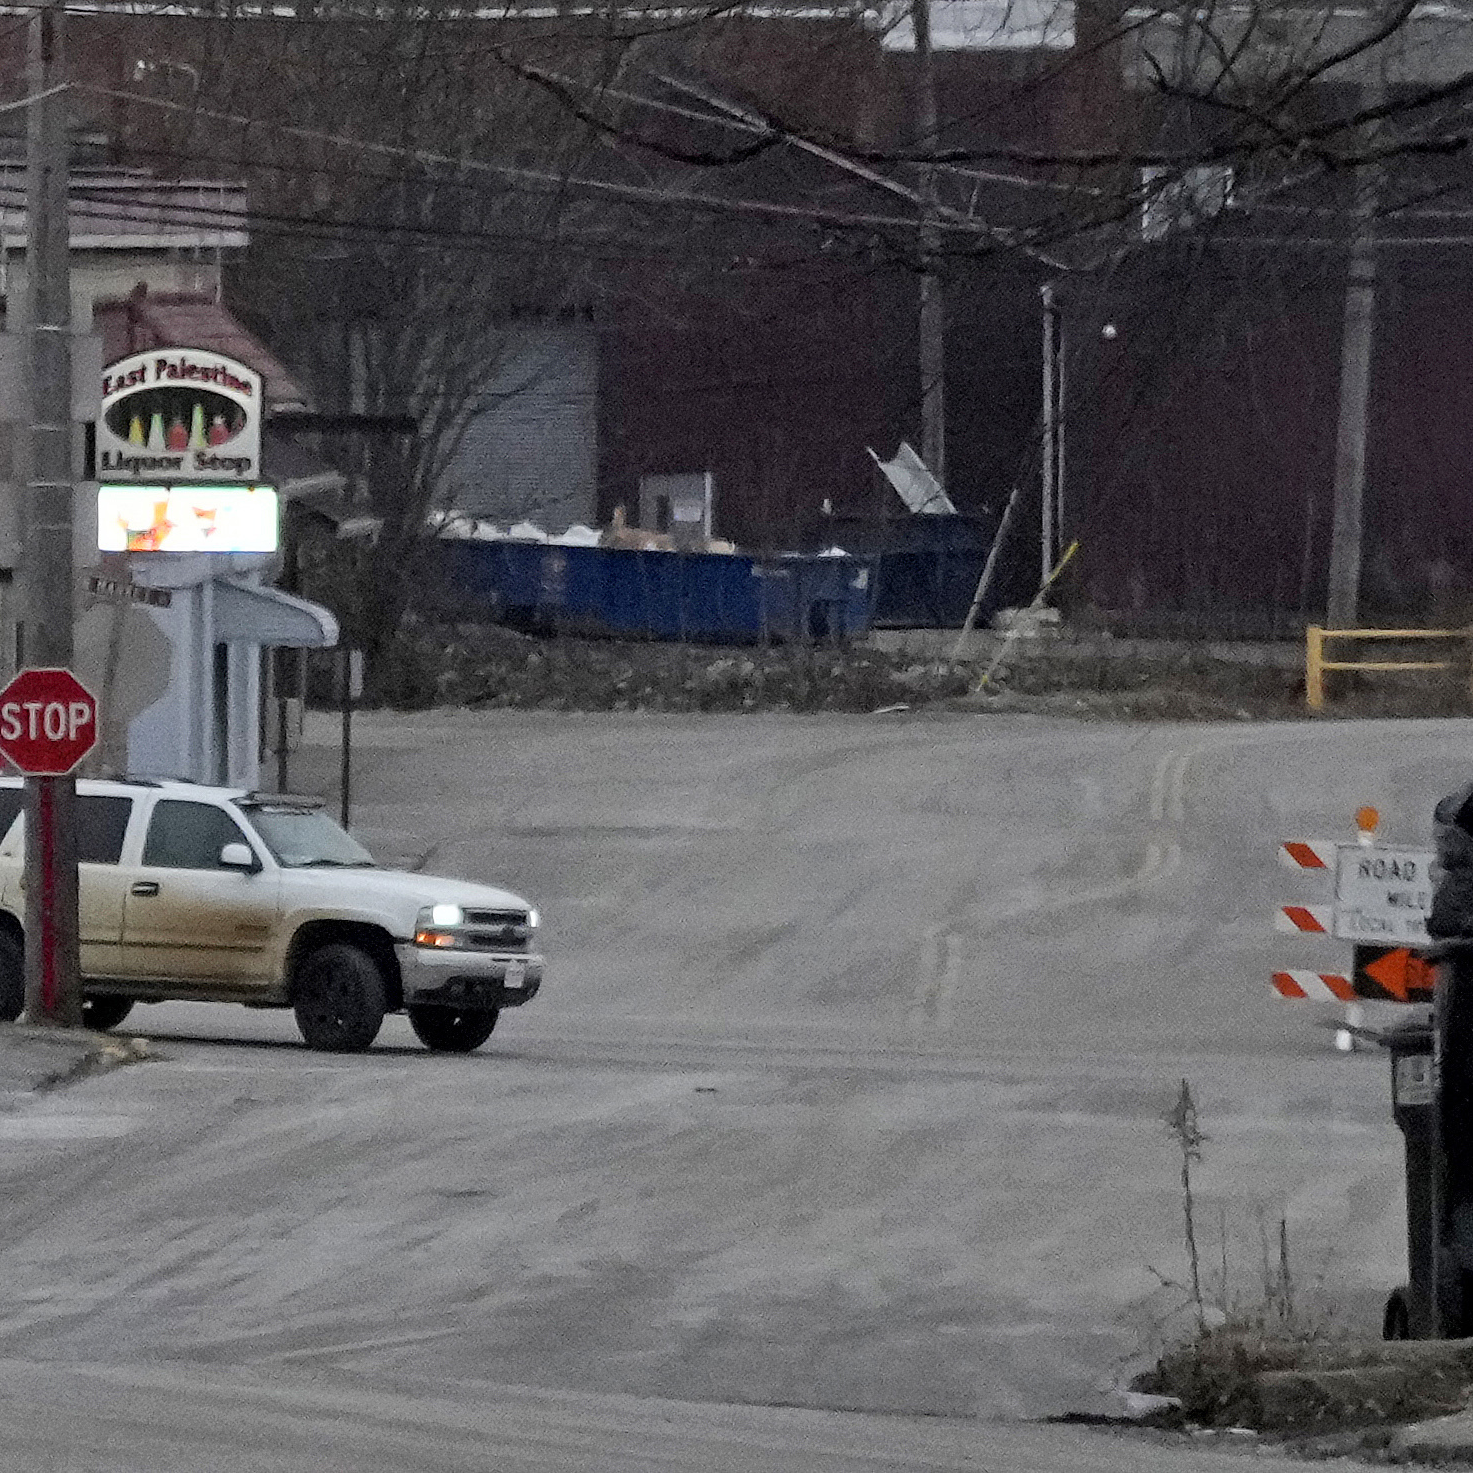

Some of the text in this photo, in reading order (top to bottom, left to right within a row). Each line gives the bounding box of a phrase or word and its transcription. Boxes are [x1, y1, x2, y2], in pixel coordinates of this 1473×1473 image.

[102, 357, 252, 396] East Palestine
[102, 449, 184, 476] Liquor
[1, 703, 91, 740] STOP
[1358, 859, 1416, 881] ROAD
